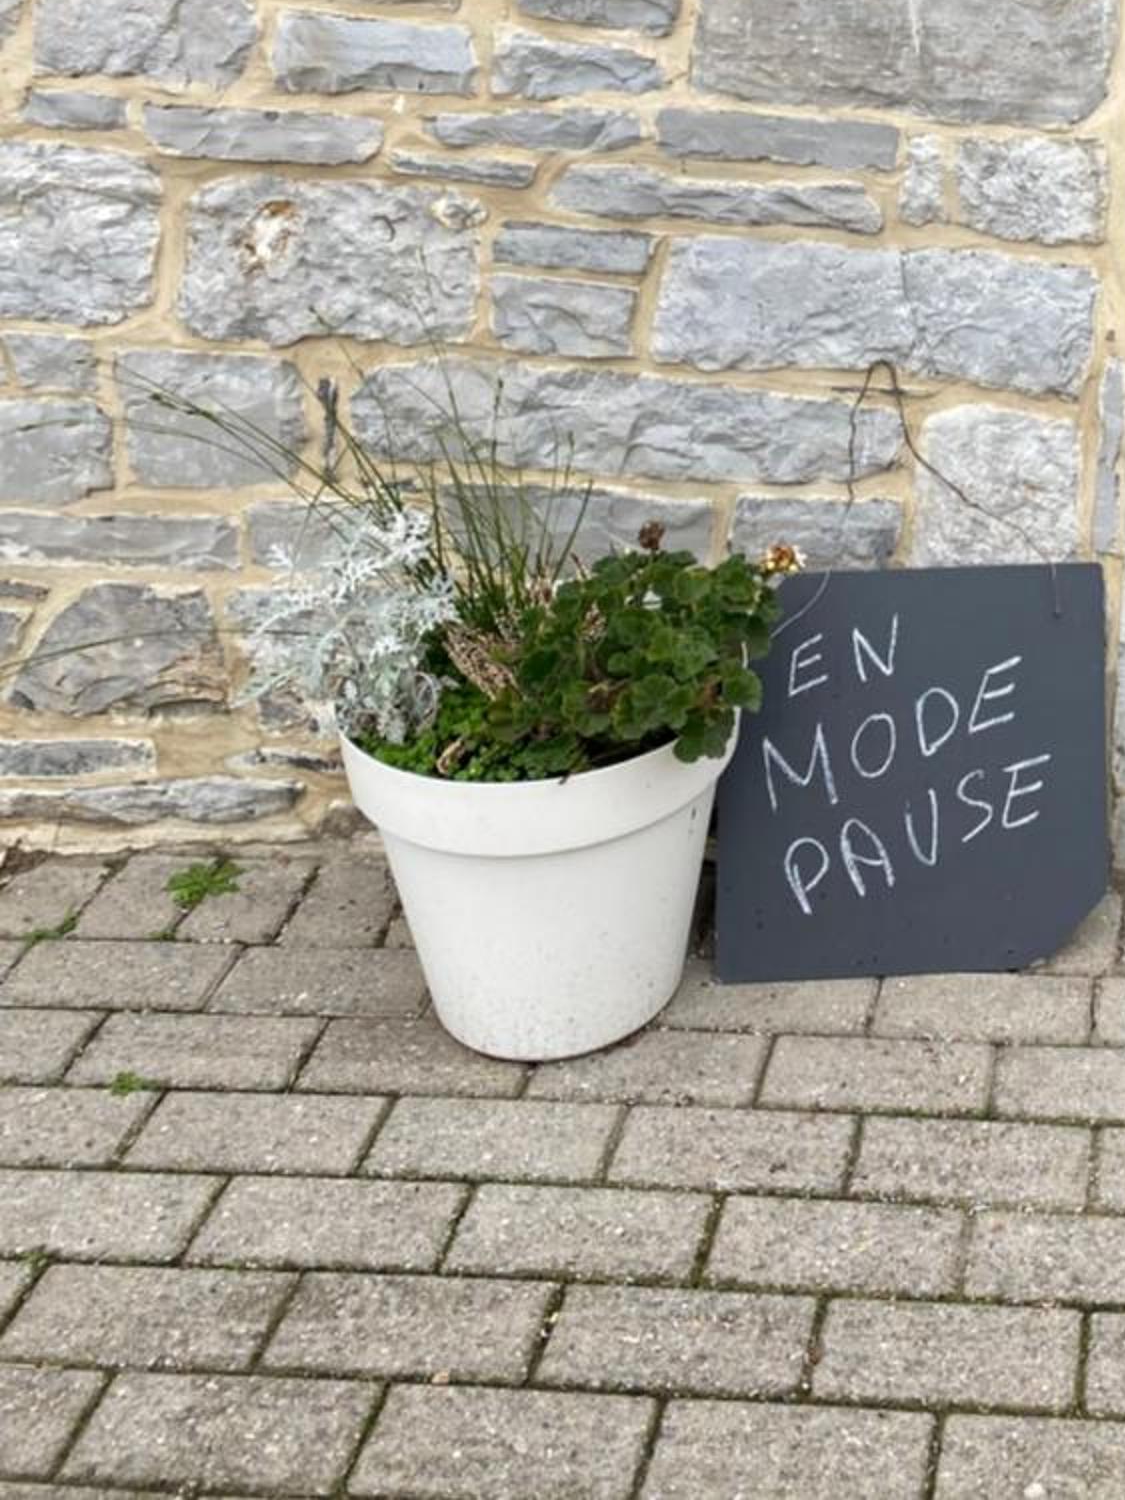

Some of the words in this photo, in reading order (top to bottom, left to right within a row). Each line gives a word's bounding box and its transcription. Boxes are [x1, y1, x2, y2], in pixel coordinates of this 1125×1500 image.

[763, 655, 1023, 811] MODE
[788, 613, 899, 697] EN
[784, 753, 1051, 915] PAUSE
